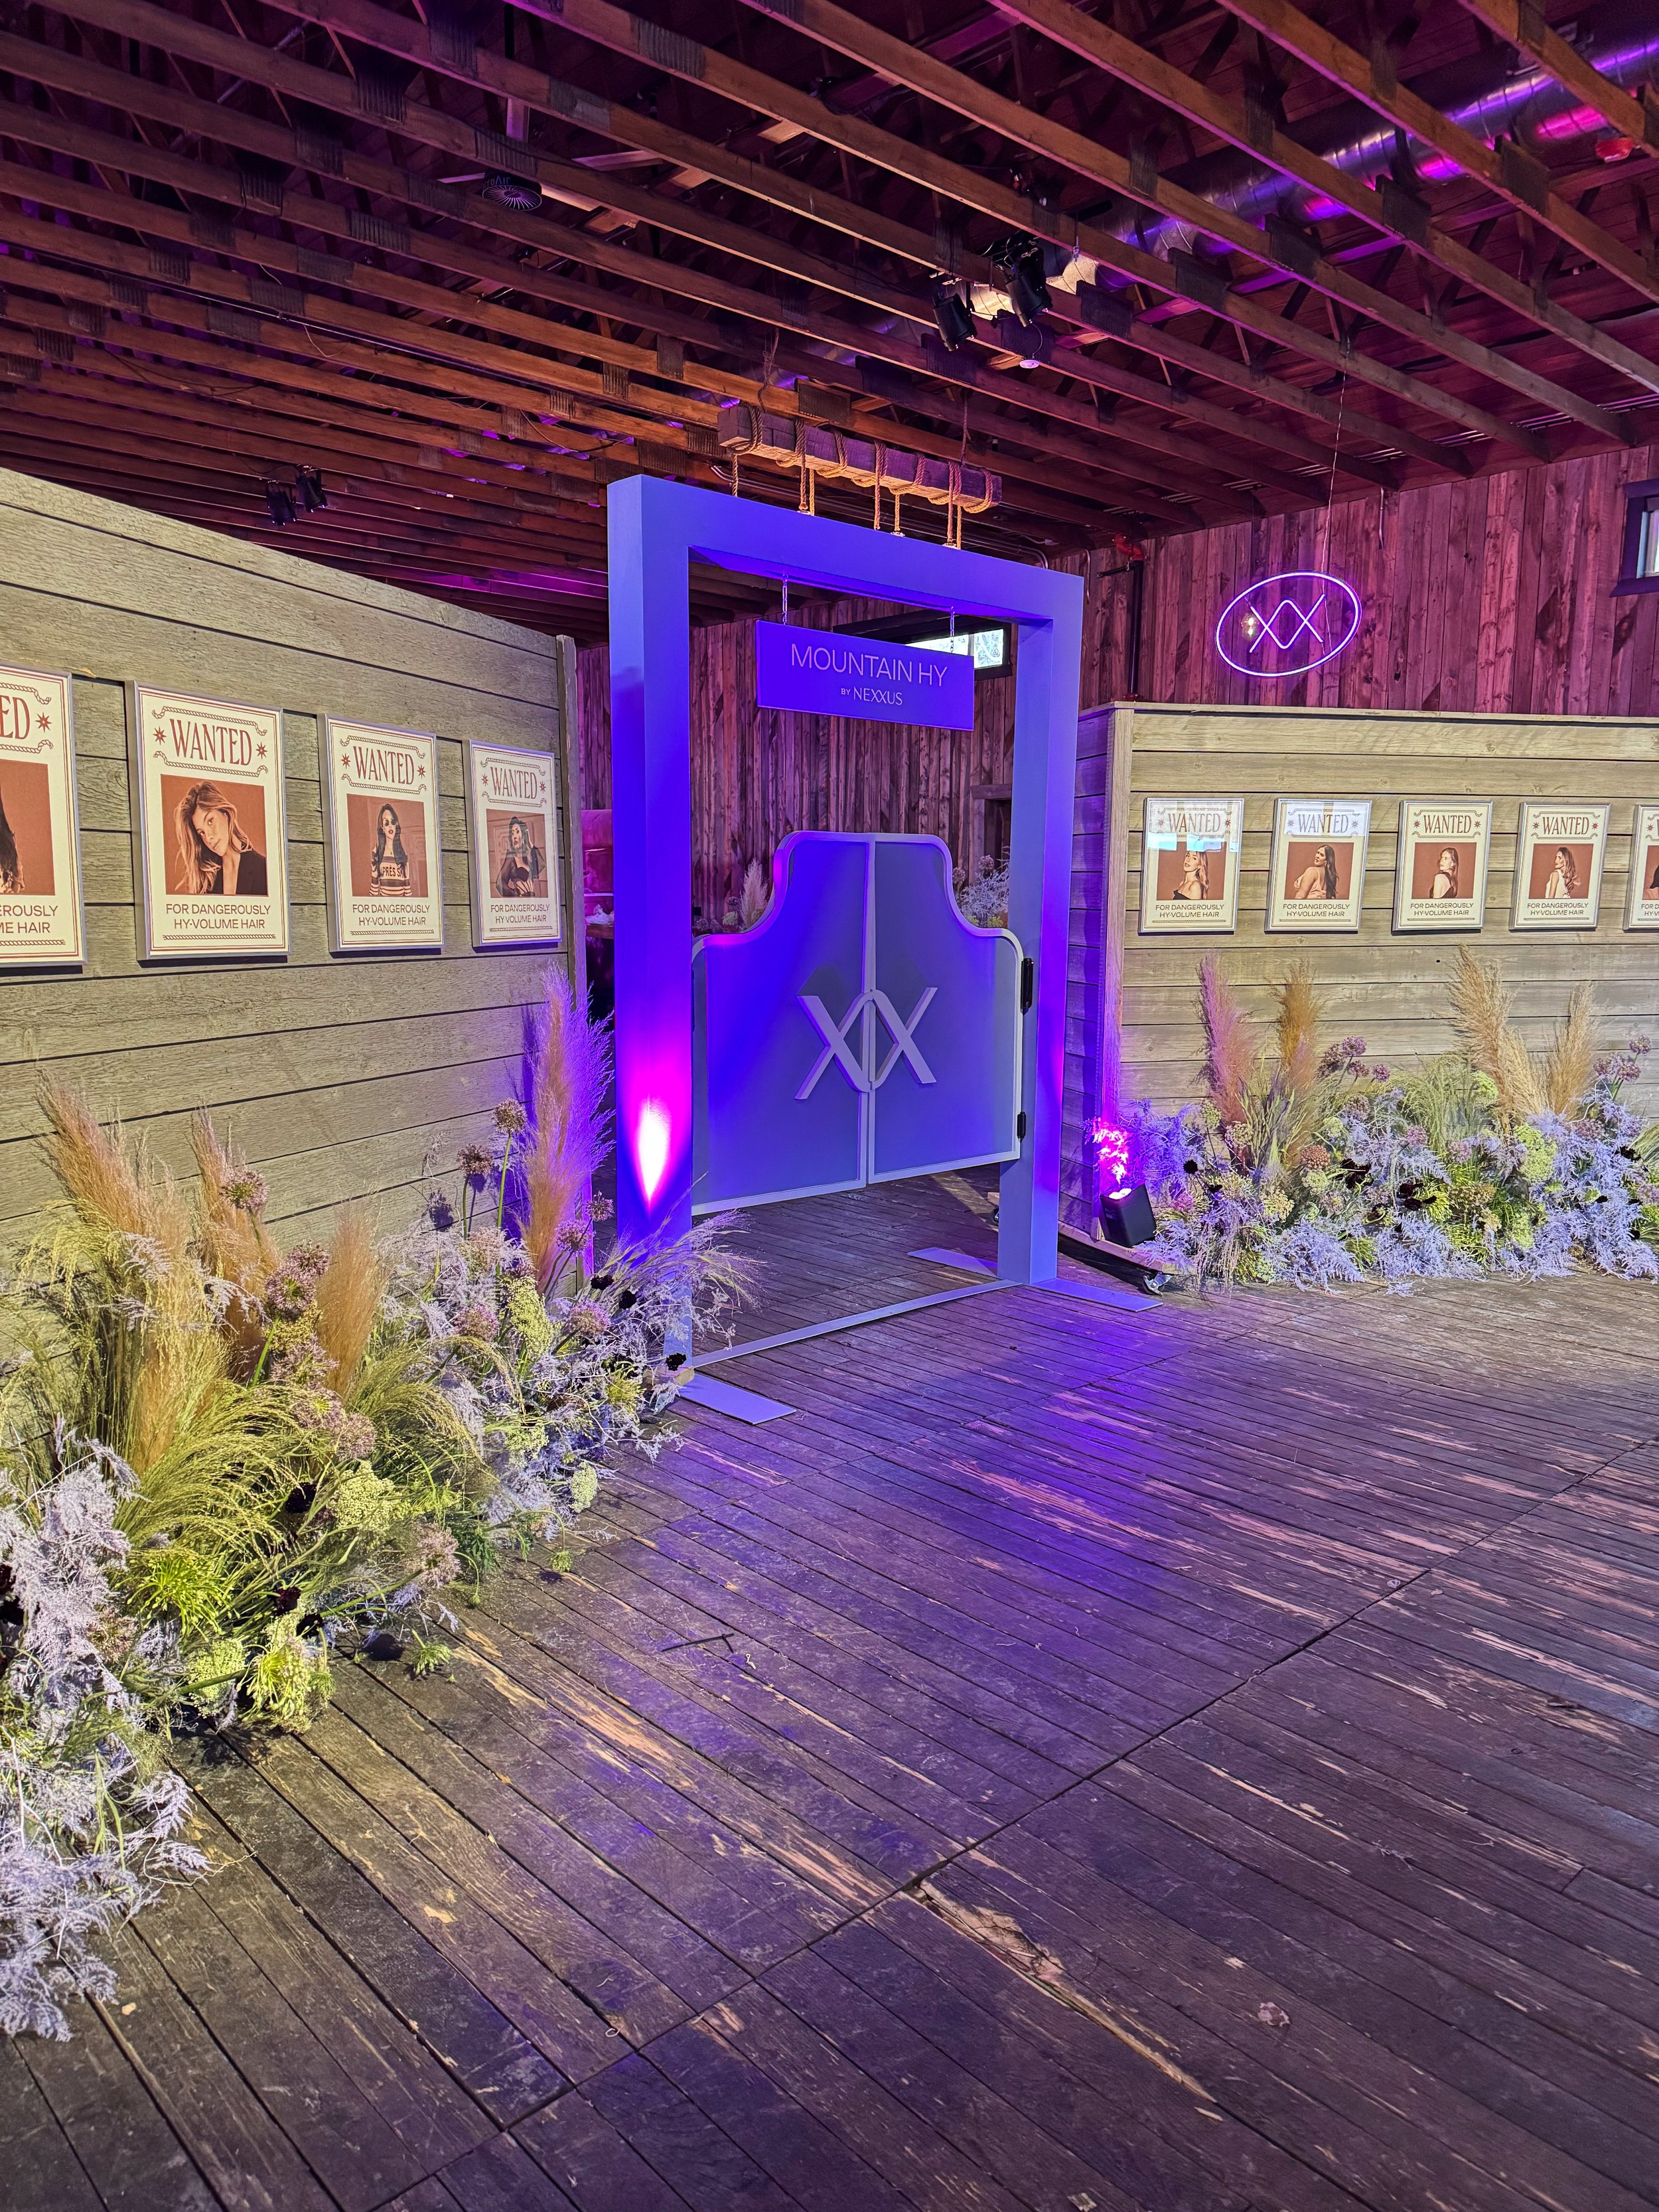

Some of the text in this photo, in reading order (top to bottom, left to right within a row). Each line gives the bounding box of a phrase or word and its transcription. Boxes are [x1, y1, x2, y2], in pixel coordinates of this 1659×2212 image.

[792, 643, 948, 687] MOUNTAIN HY
[853, 686, 903, 706] NEXXUS
[169, 718, 252, 766] WANTED
[353, 746, 415, 785] WANTED
[490, 767, 538, 800] WANTED
[1168, 813, 1222, 833] WANTED
[1297, 814, 1349, 834] WANTED
[1423, 815, 1472, 834] WANTED
[1542, 816, 1590, 835] WANTED
[166, 903, 271, 915] FOR DANGEROUSLY
[352, 904, 431, 913] FOR DANGEROUSLY
[505, 904, 550, 913] DANGEROUSLY
[17, 922, 51, 934] HAIR
[174, 919, 266, 929] HY-VOLUME HAIR
[358, 917, 427, 926] HY-VOLUME HAIR
